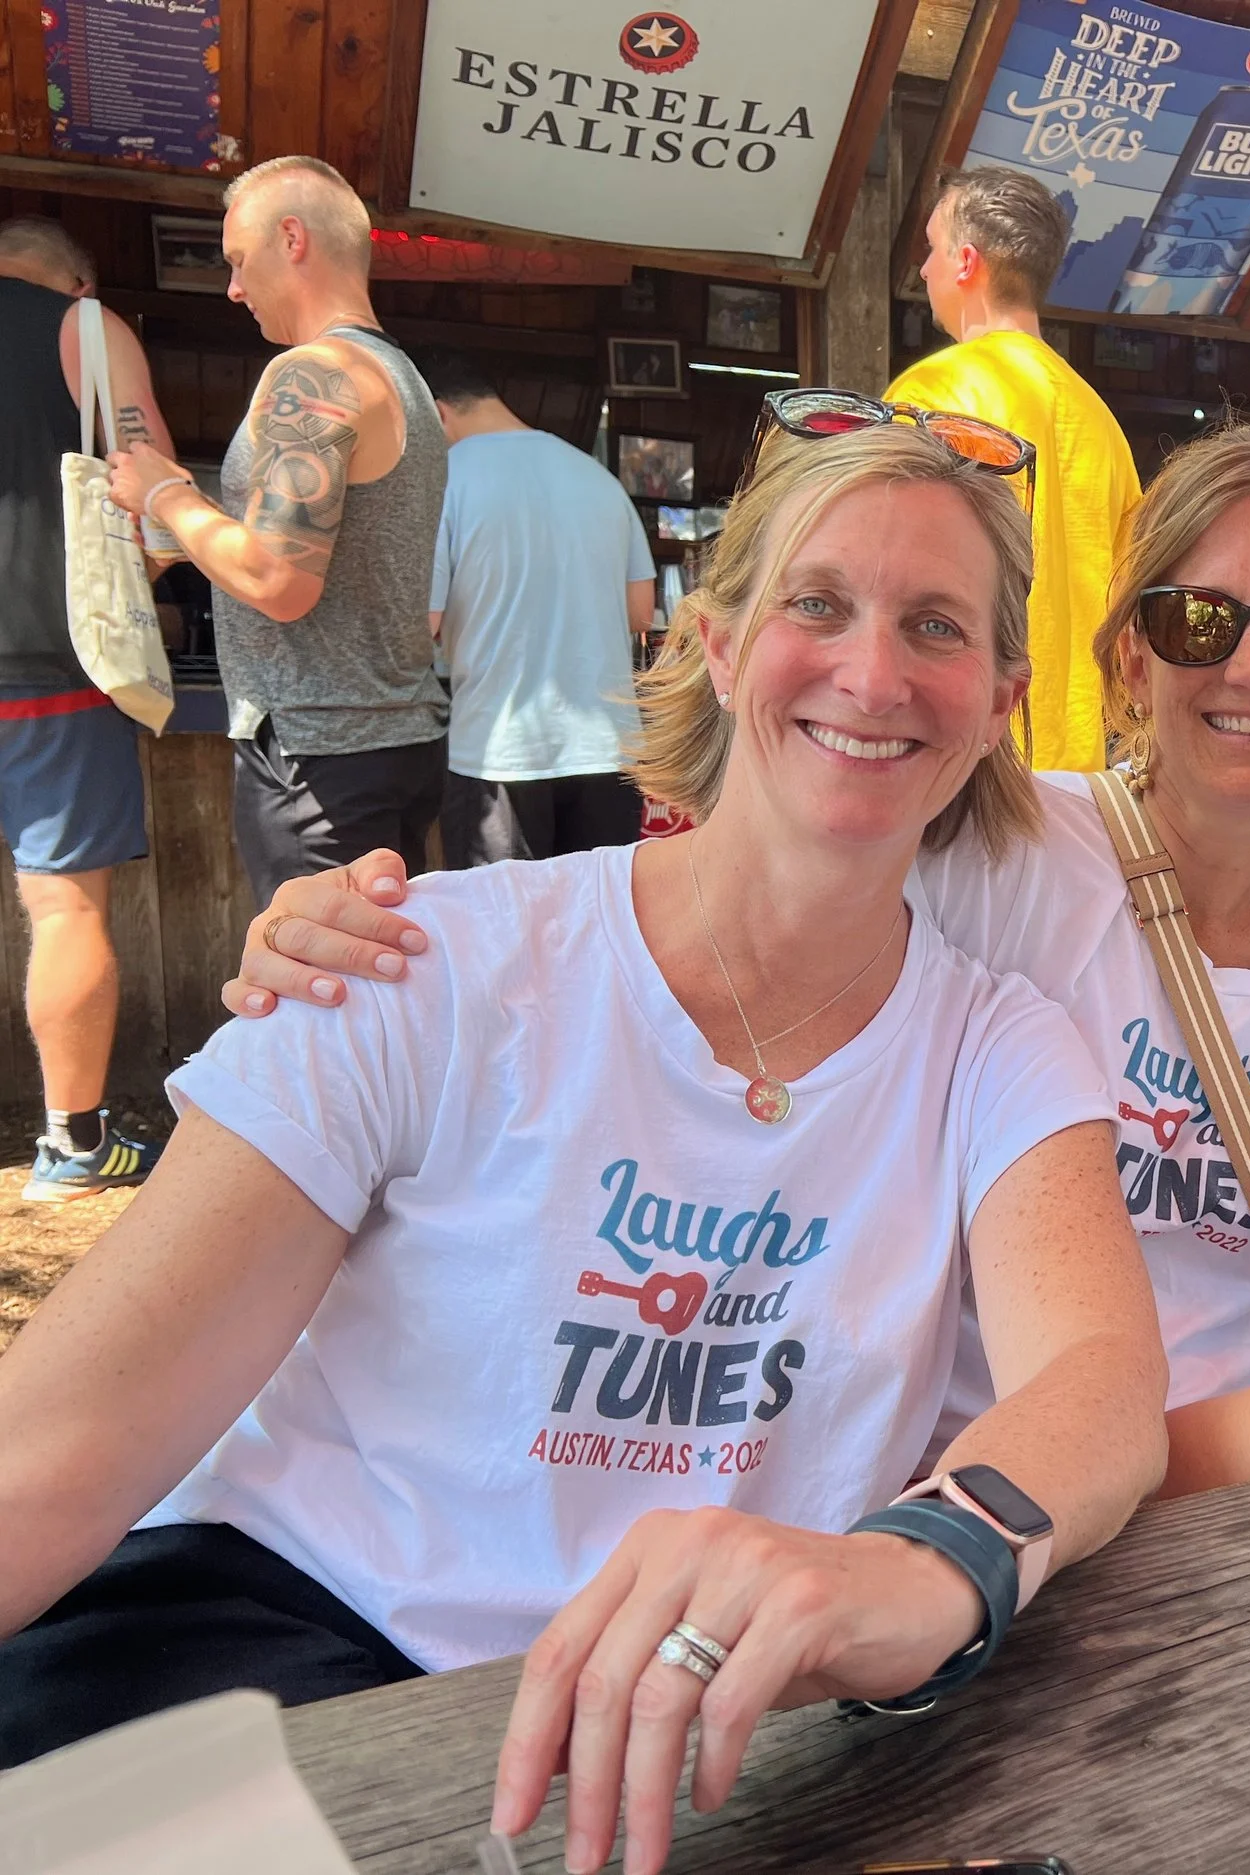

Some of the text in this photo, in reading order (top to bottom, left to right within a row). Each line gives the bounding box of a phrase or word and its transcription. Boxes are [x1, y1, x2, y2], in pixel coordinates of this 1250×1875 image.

[1071, 14, 1182, 68] DEEP
[1110, 6, 1161, 31] BREWED
[452, 47, 815, 139] ESTRELLA
[1038, 47, 1176, 122] HEART
[1086, 52, 1142, 80] IN THE
[482, 101, 777, 173] JALISCO
[1007, 91, 1148, 165] Texas
[1091, 105, 1116, 120] OF
[596, 1158, 830, 1292] Laughs
[1196, 1225, 1248, 1253] 2022
[703, 1280, 794, 1327] and
[551, 1320, 806, 1427] TUNES
[617, 1439, 693, 1475] TEXAS
